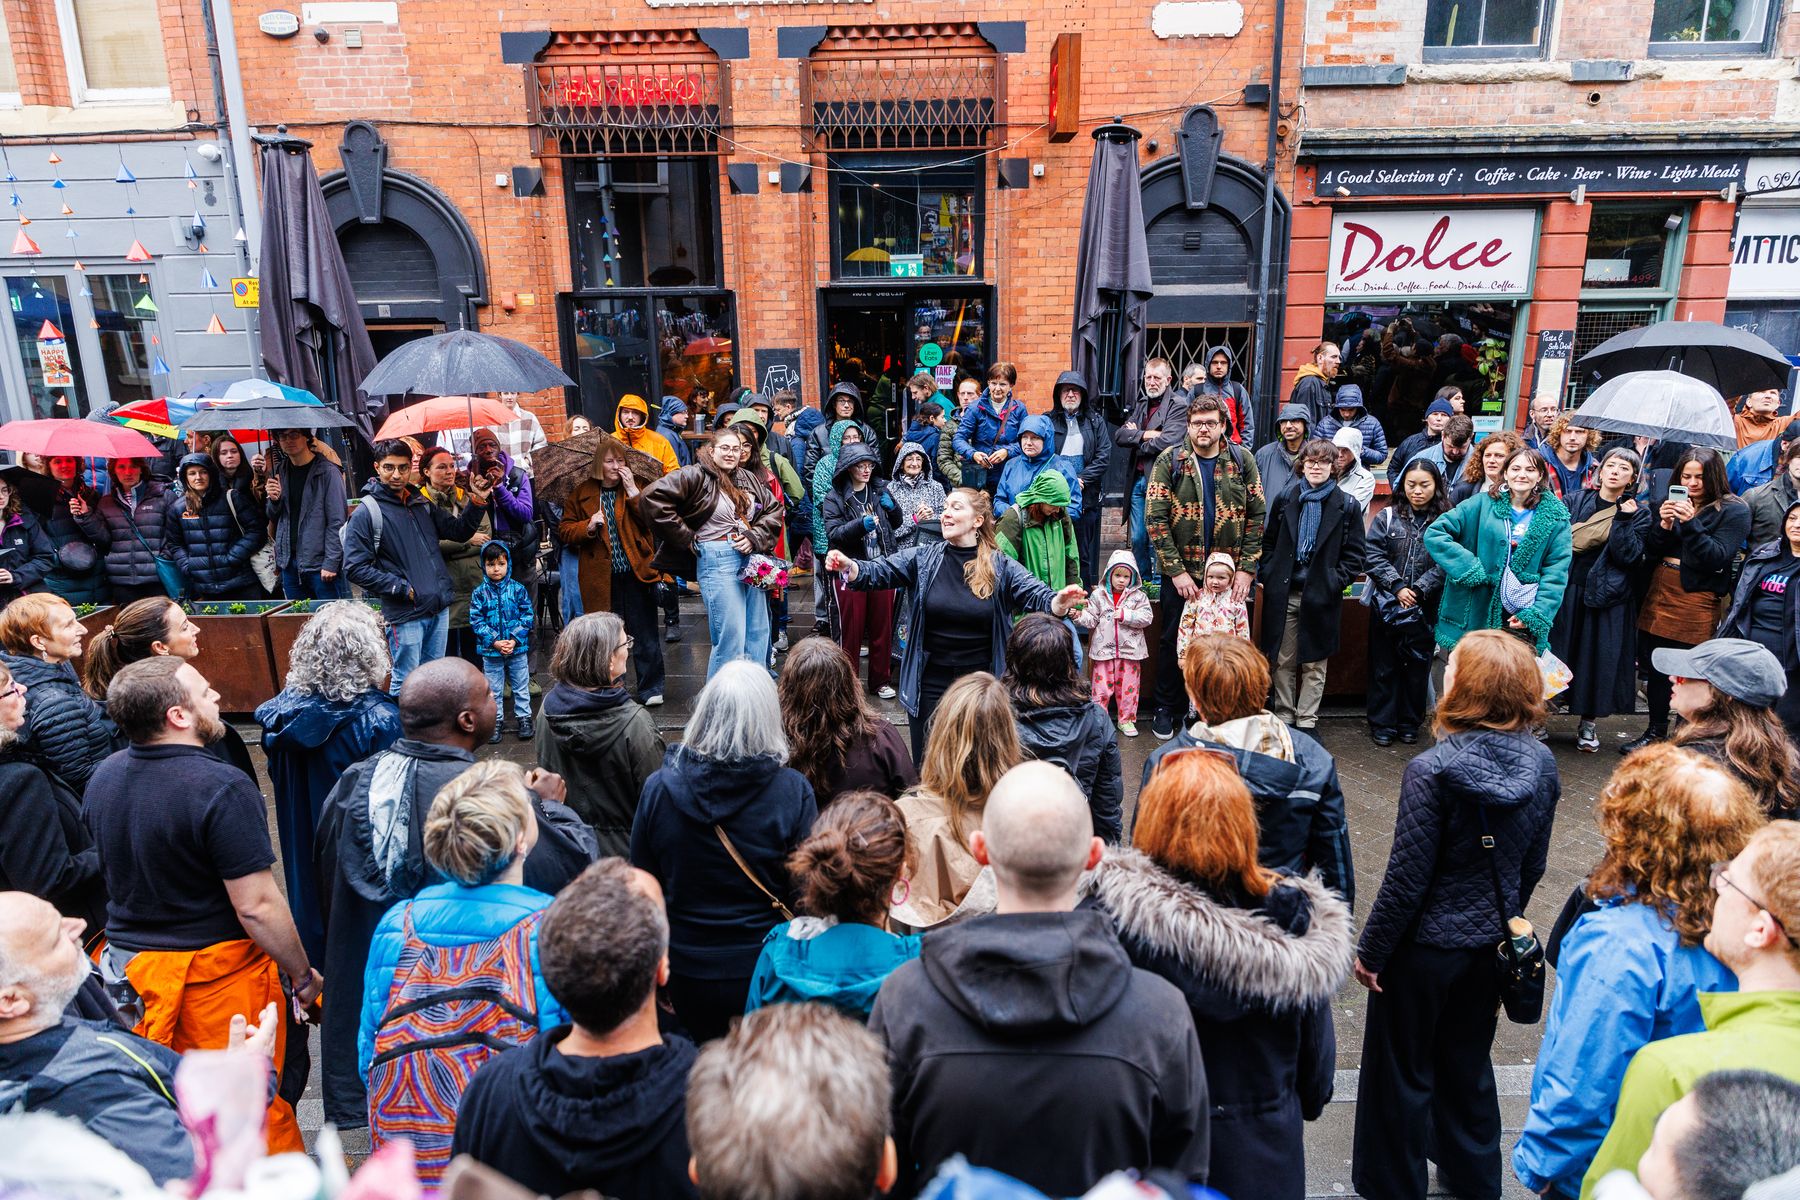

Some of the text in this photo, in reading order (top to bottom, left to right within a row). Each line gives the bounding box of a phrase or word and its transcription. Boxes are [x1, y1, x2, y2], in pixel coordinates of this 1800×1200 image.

[618, 78, 695, 100] HPPO
[1321, 171, 1333, 184] A
[1337, 170, 1374, 184] Good
[1375, 169, 1434, 184] Selection
[1438, 168, 1456, 186] of
[1474, 168, 1516, 185] Coffee
[1527, 166, 1561, 180] Cake
[1571, 166, 1604, 180] Beer
[1616, 165, 1650, 179] Wine
[1659, 165, 1698, 183] Light
[1698, 164, 1741, 179] Meals
[1340, 215, 1512, 282] Dolce
[1734, 235, 1800, 264] ATTIC
[1542, 331, 1557, 342] Pasta
[1559, 341, 1572, 349] Drink
[935, 366, 952, 375] TAKE
[936, 377, 952, 385] PRIDE
